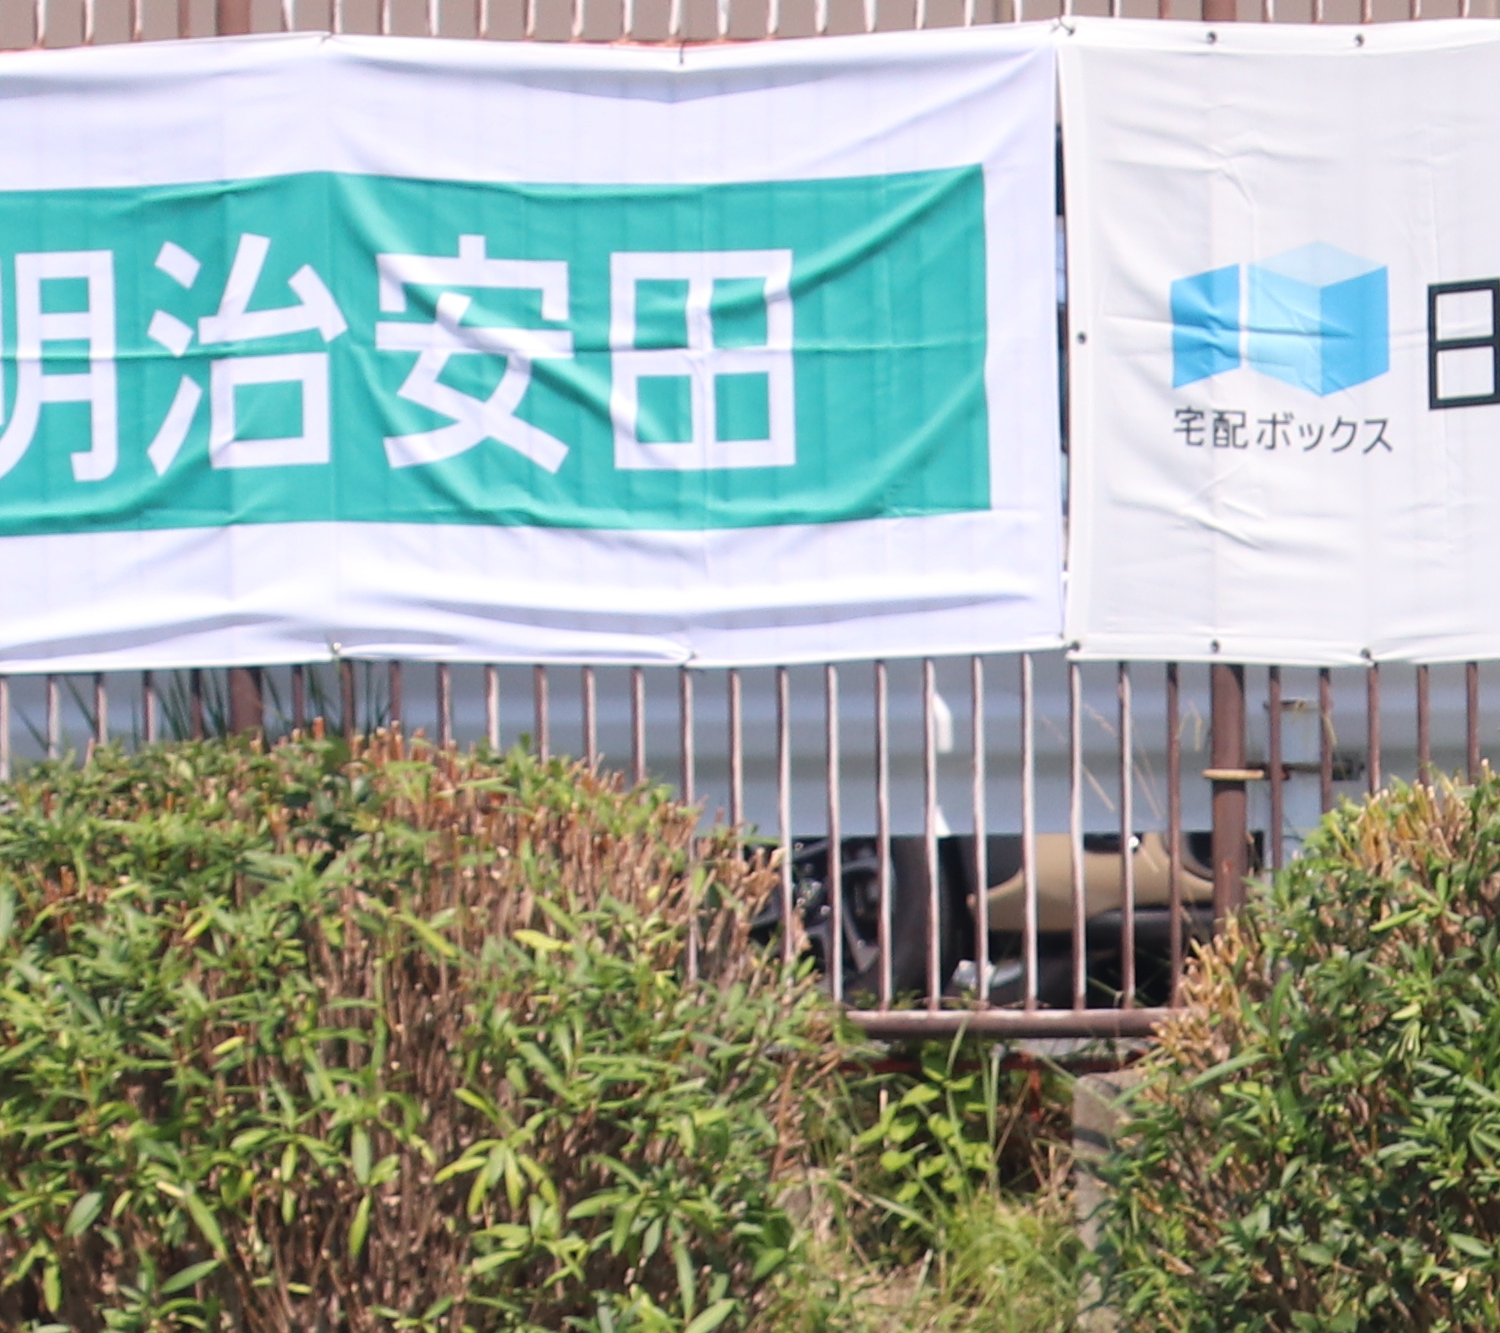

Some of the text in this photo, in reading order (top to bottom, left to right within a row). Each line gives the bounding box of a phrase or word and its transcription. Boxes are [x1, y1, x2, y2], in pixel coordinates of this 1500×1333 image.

[1173, 406, 1393, 454] 宅配ボックス
